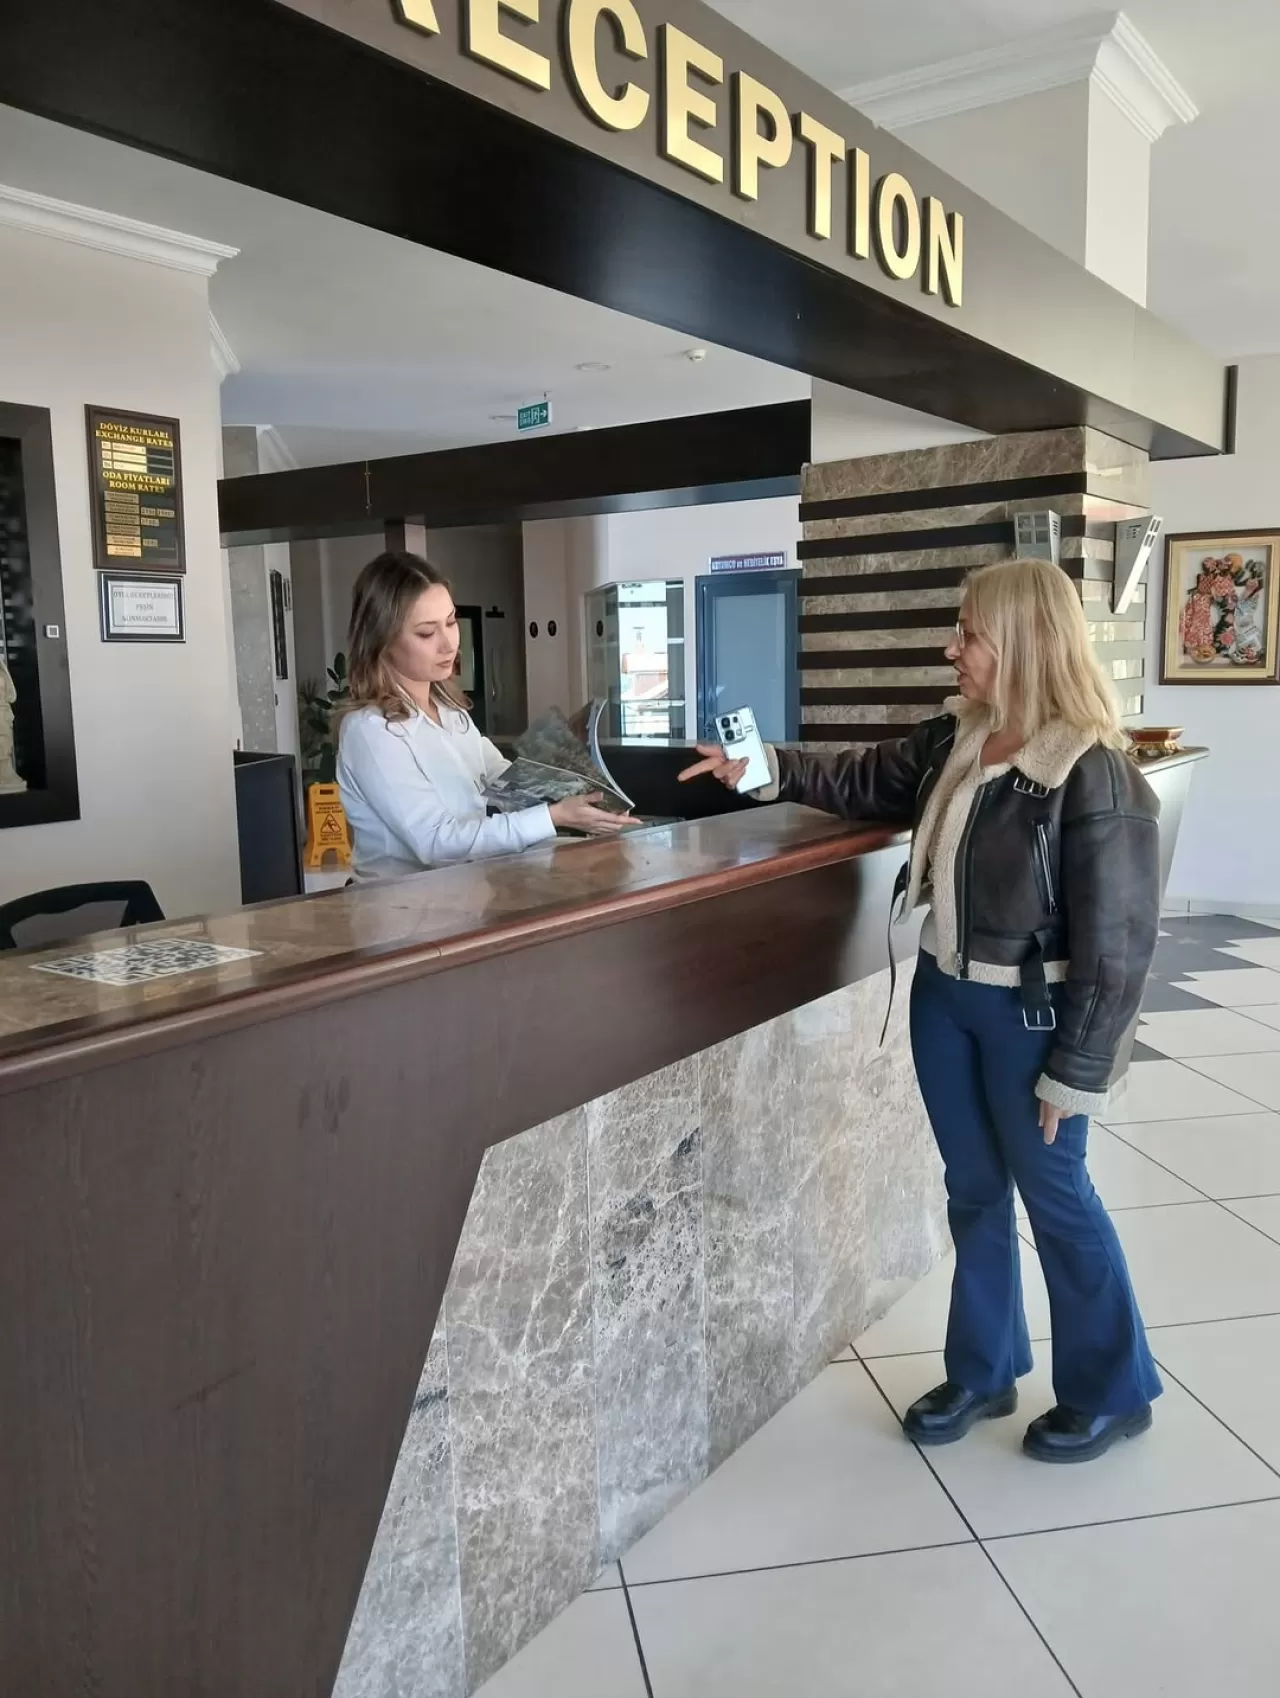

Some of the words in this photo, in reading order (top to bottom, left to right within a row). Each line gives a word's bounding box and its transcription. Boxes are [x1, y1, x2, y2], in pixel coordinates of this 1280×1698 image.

[391, 0, 963, 308] ECEPTION
[100, 422, 129, 433] DÖVİZ
[95, 429, 145, 443] EXCHANGE
[146, 438, 174, 447] RATES
[102, 471, 122, 480] ODA
[109, 480, 135, 490] ROOM
[138, 484, 165, 493] RATES
